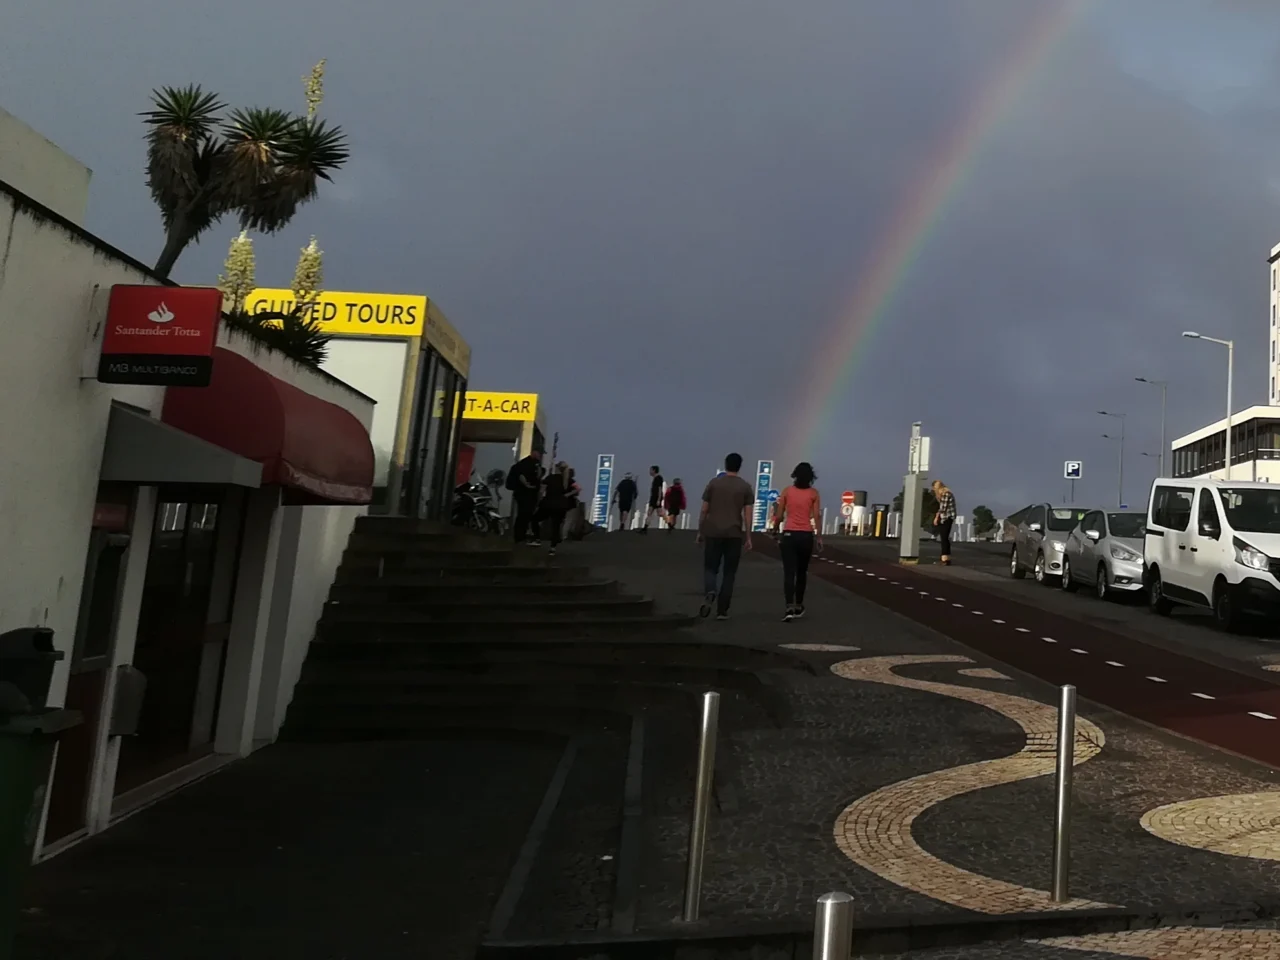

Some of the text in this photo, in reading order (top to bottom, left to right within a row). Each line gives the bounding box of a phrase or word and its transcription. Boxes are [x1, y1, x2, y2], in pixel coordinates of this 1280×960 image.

[253, 298, 417, 325] GUIED TOURS
[115, 325, 201, 337] Santander Totta
[1067, 463, 1079, 473] P
